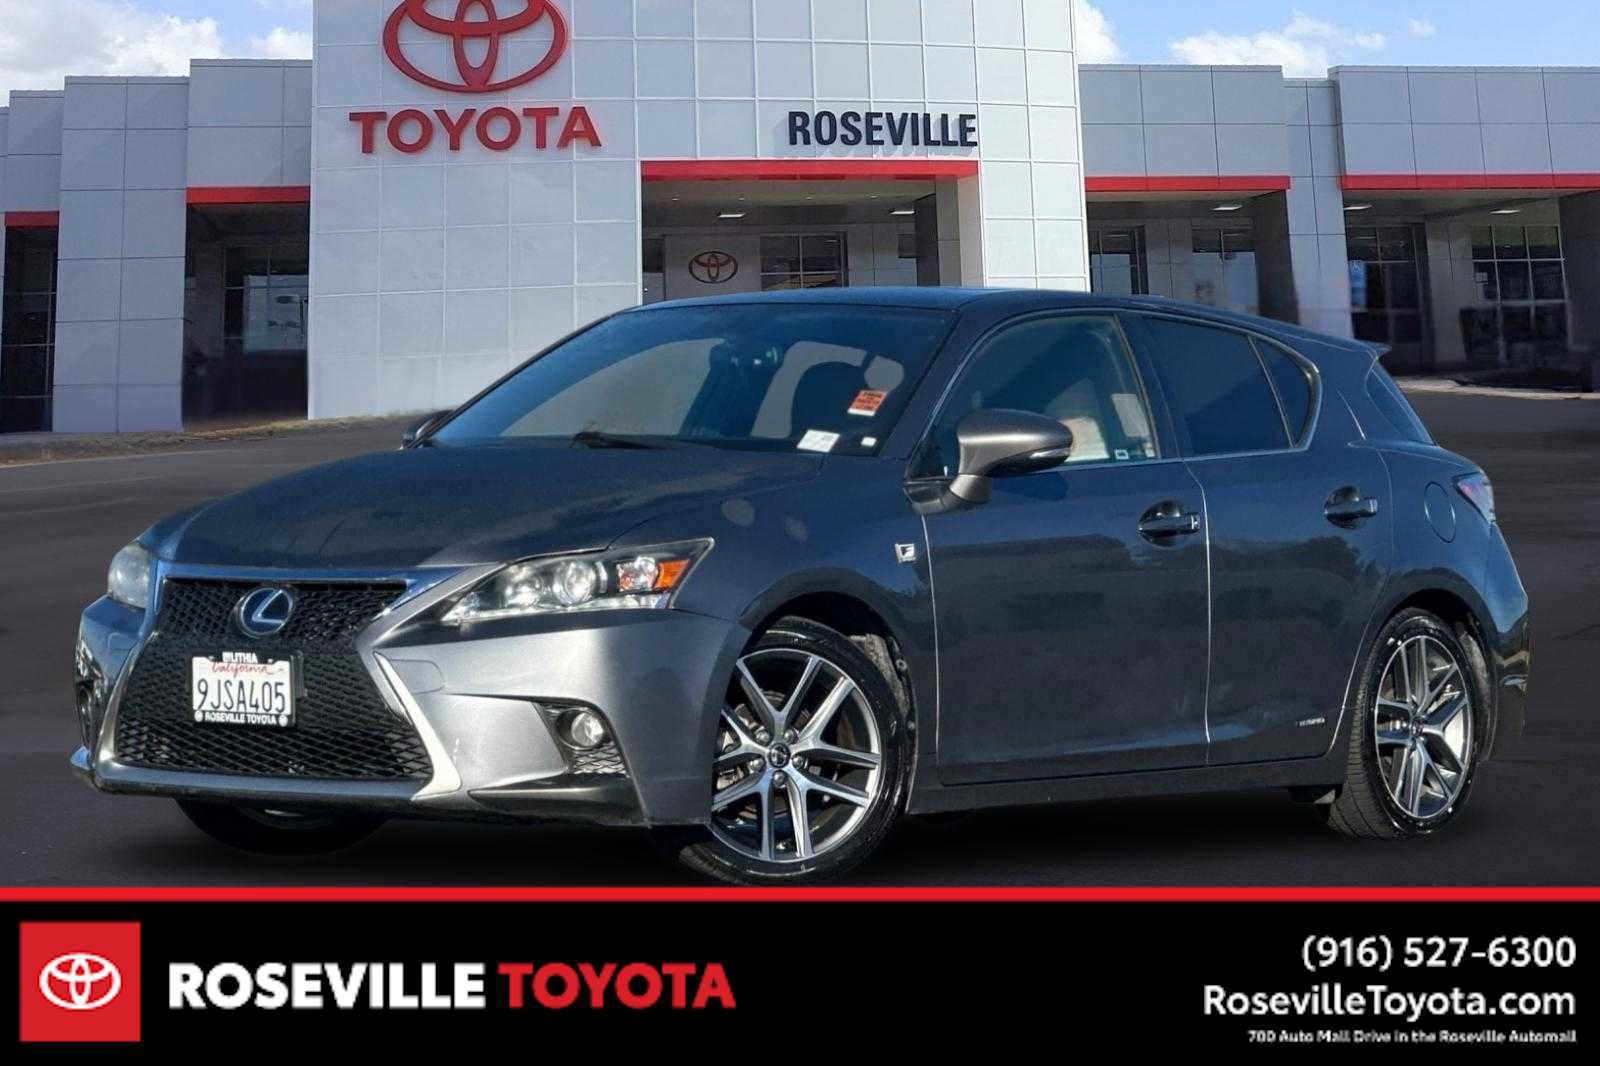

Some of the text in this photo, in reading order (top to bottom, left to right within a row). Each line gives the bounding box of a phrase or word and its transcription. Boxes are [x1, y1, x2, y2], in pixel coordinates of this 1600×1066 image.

[349, 106, 602, 154] TOYOTA
[788, 110, 978, 147] ROSEVILLE
[197, 678, 286, 713] 9JSA405
[205, 711, 277, 725] ROSEVILLE TOYOTA
